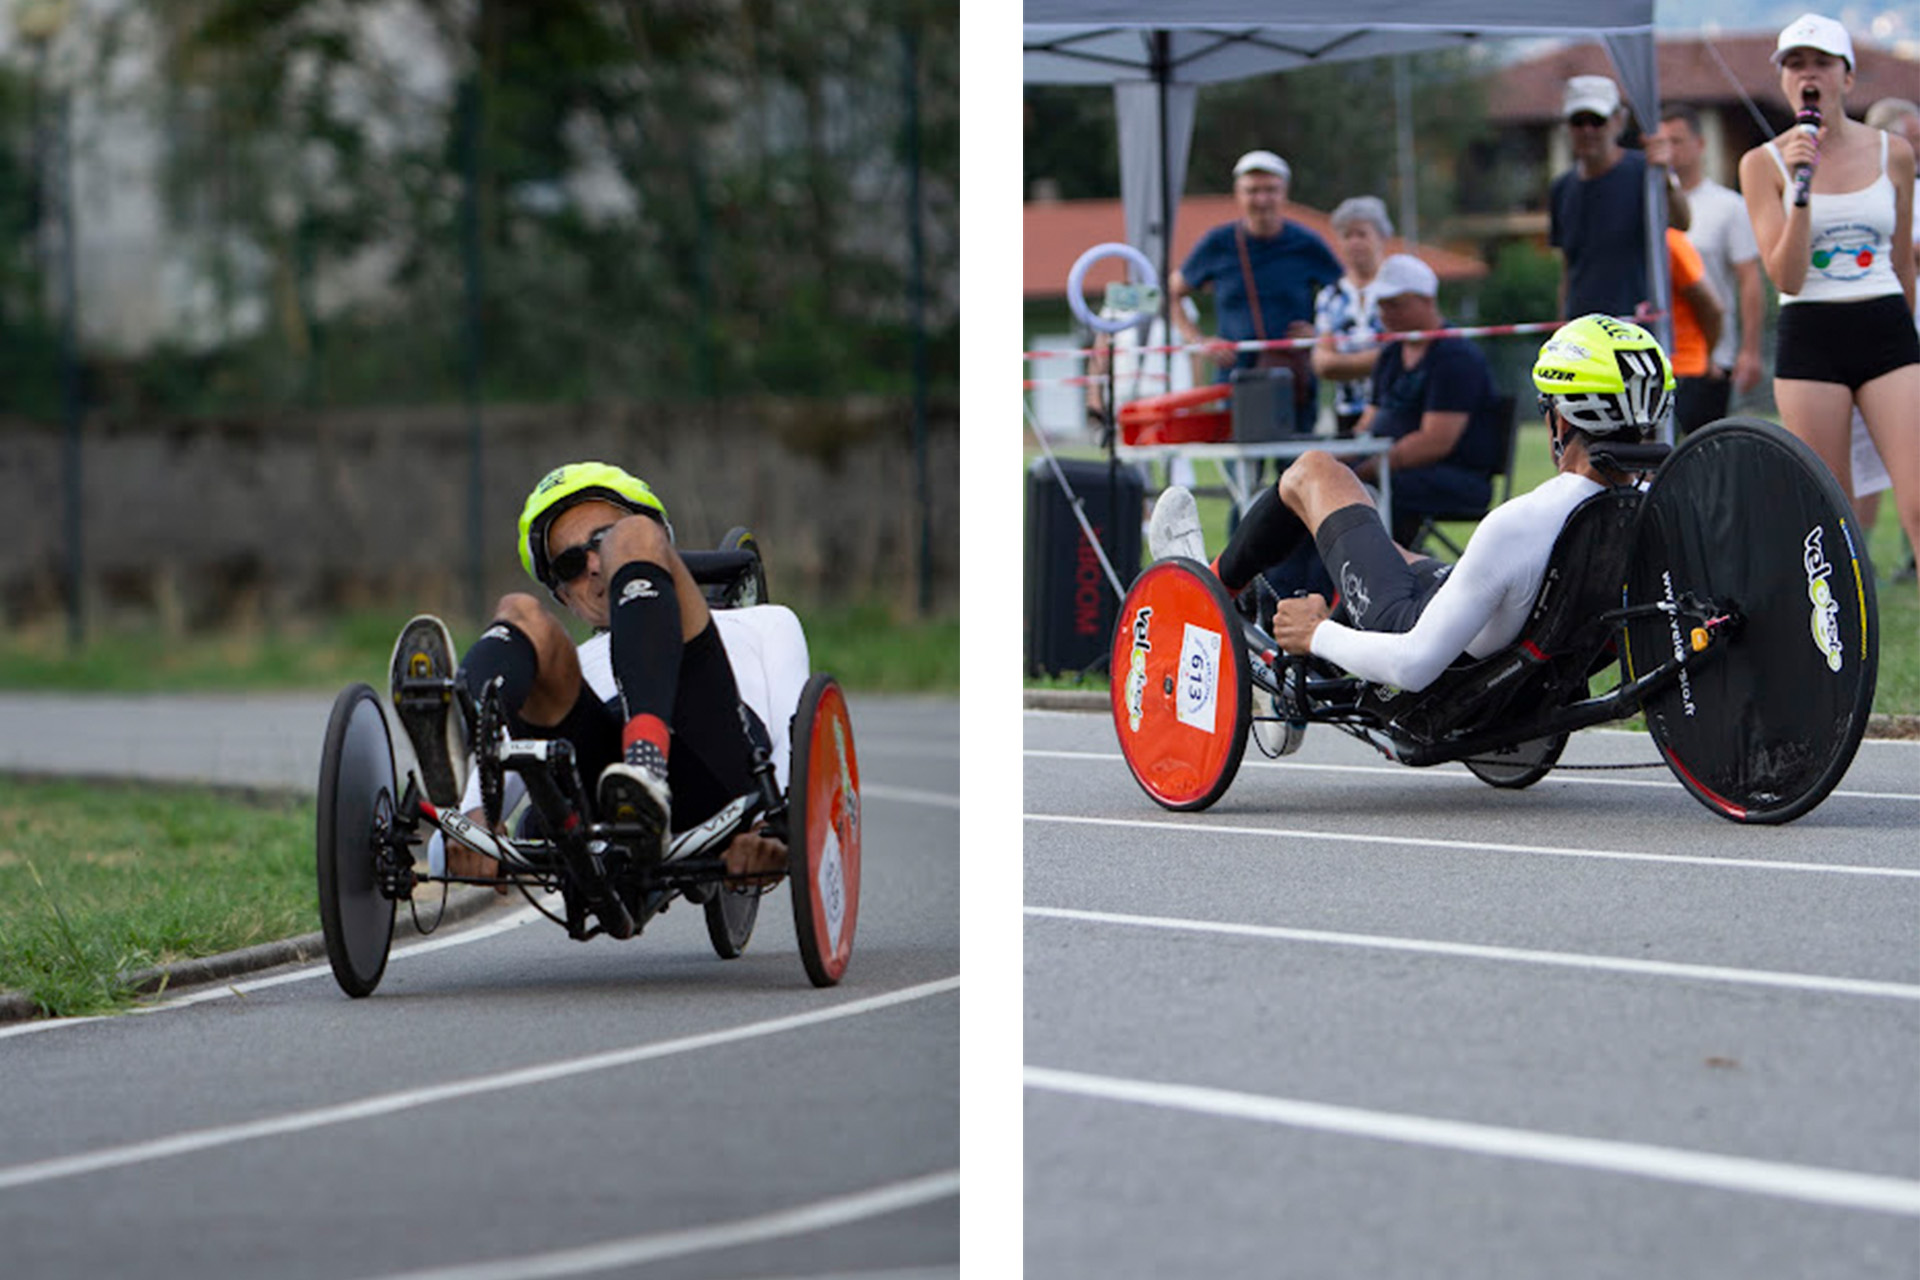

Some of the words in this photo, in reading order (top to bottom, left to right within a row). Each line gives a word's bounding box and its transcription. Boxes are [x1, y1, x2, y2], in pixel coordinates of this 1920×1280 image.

[1537, 368, 1576, 382] LAZER
[1075, 526, 1102, 635] BOOM
[1188, 654, 1204, 701] 613
